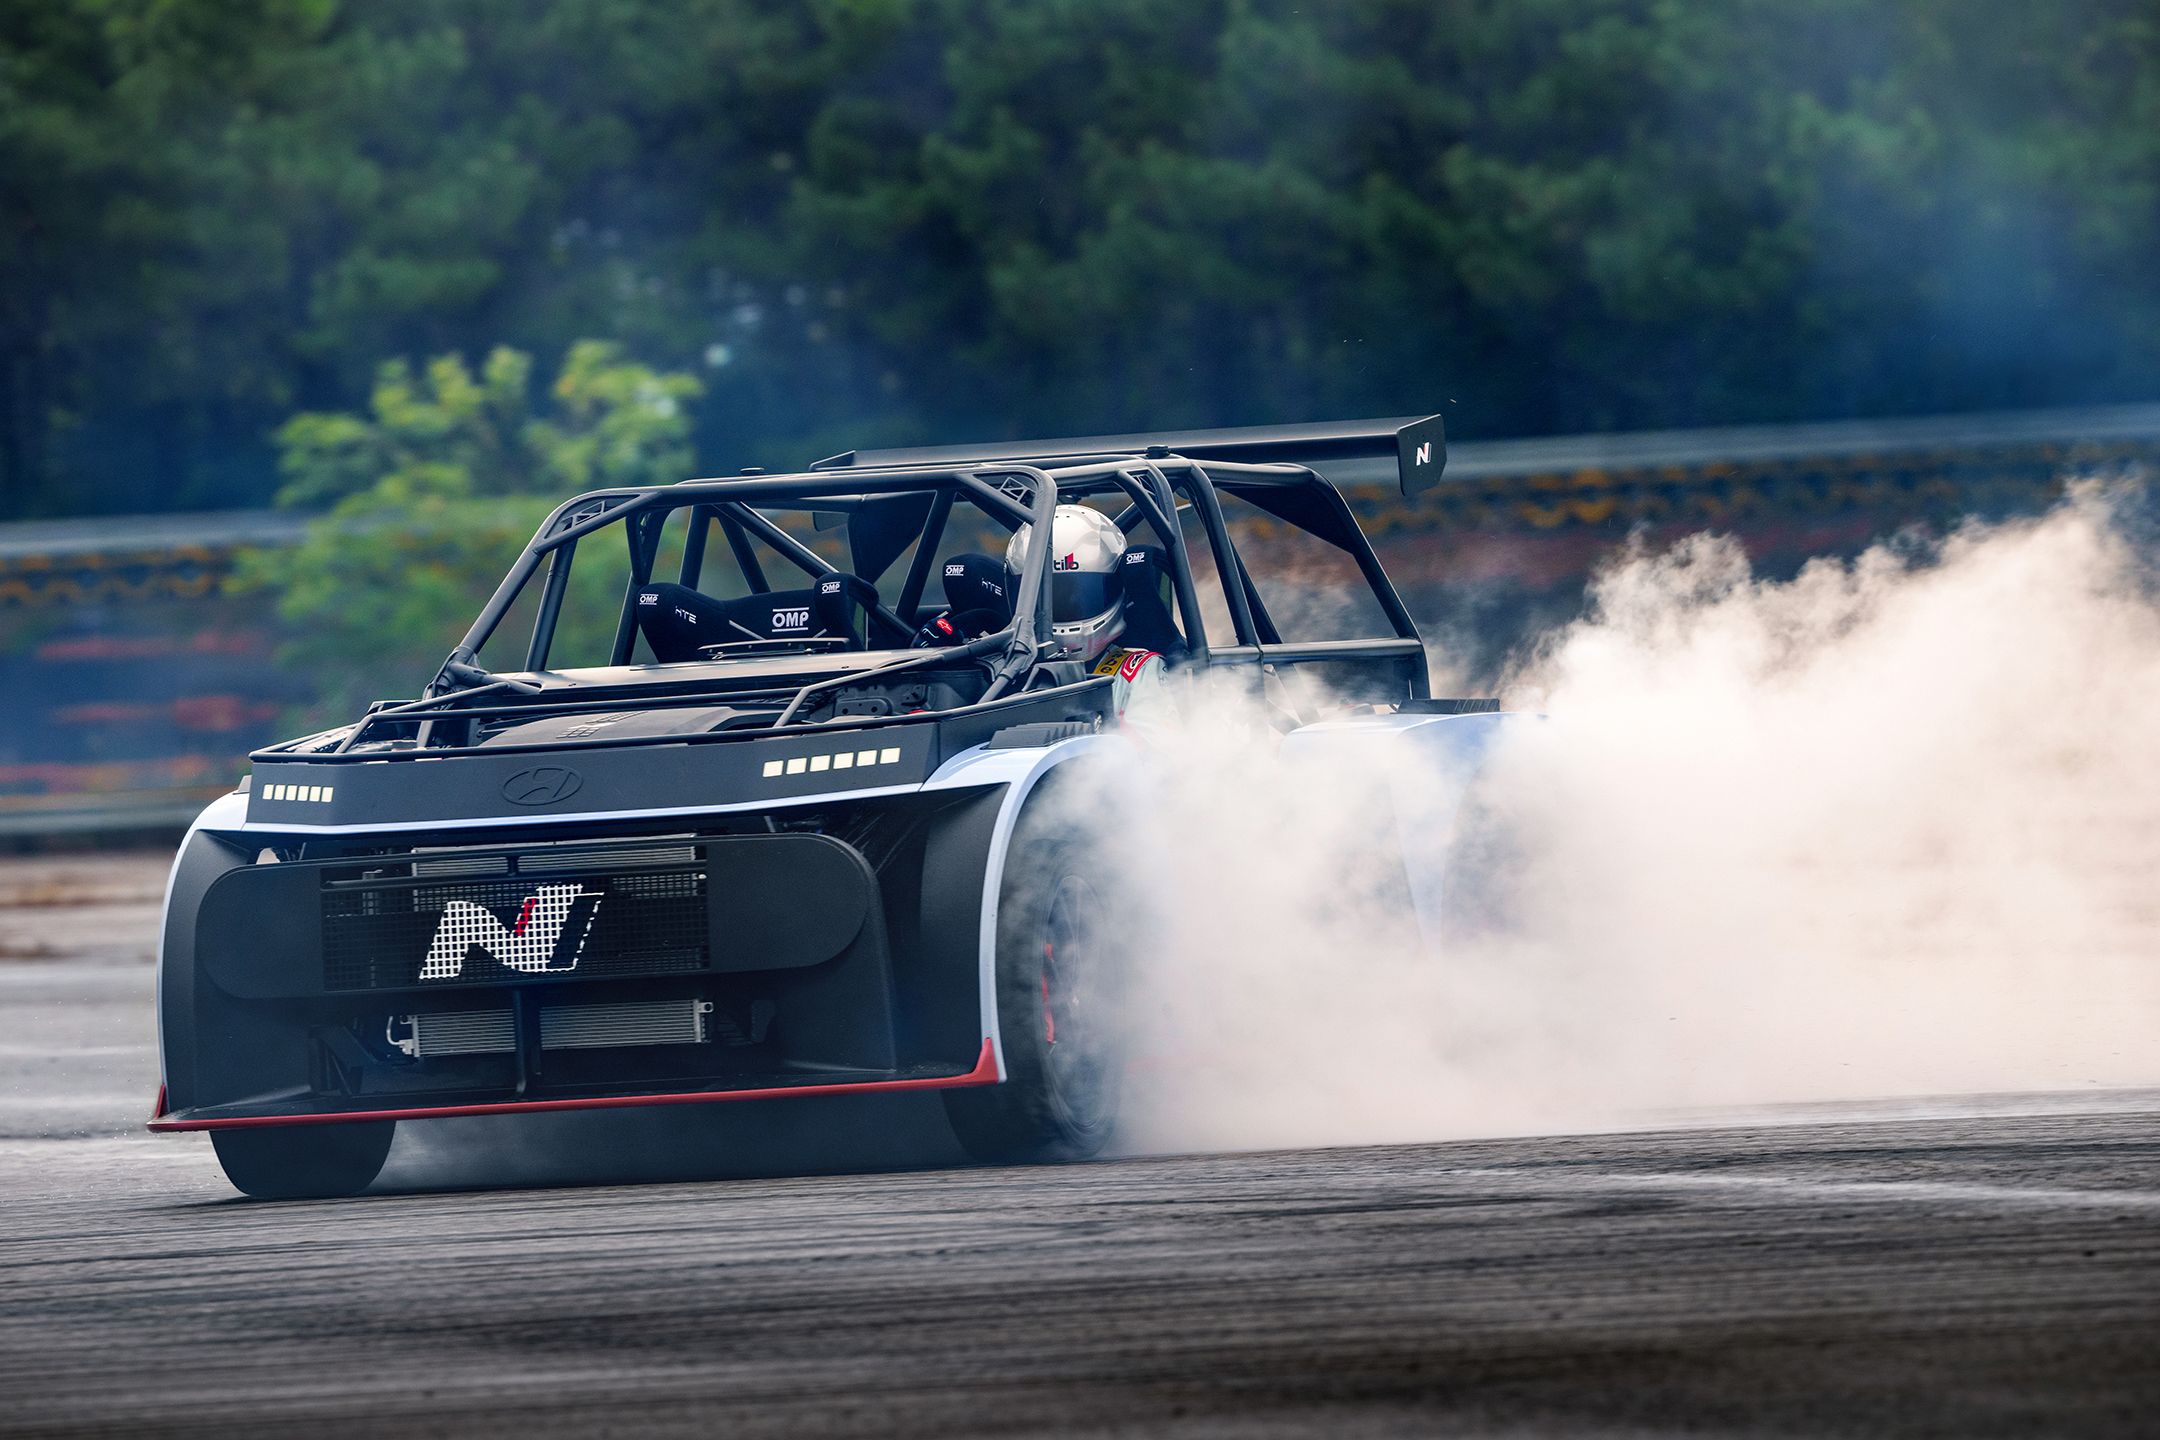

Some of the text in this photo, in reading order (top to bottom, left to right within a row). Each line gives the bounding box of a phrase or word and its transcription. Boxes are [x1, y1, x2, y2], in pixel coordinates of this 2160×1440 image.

[1416, 442, 1432, 466] N
[1053, 552, 1080, 571] tilo
[1126, 552, 1145, 564] OMP
[945, 565, 964, 576] OMP
[821, 582, 840, 593] OMP
[639, 594, 658, 605] OMP
[772, 608, 809, 631] OMP
[419, 883, 604, 979] N
